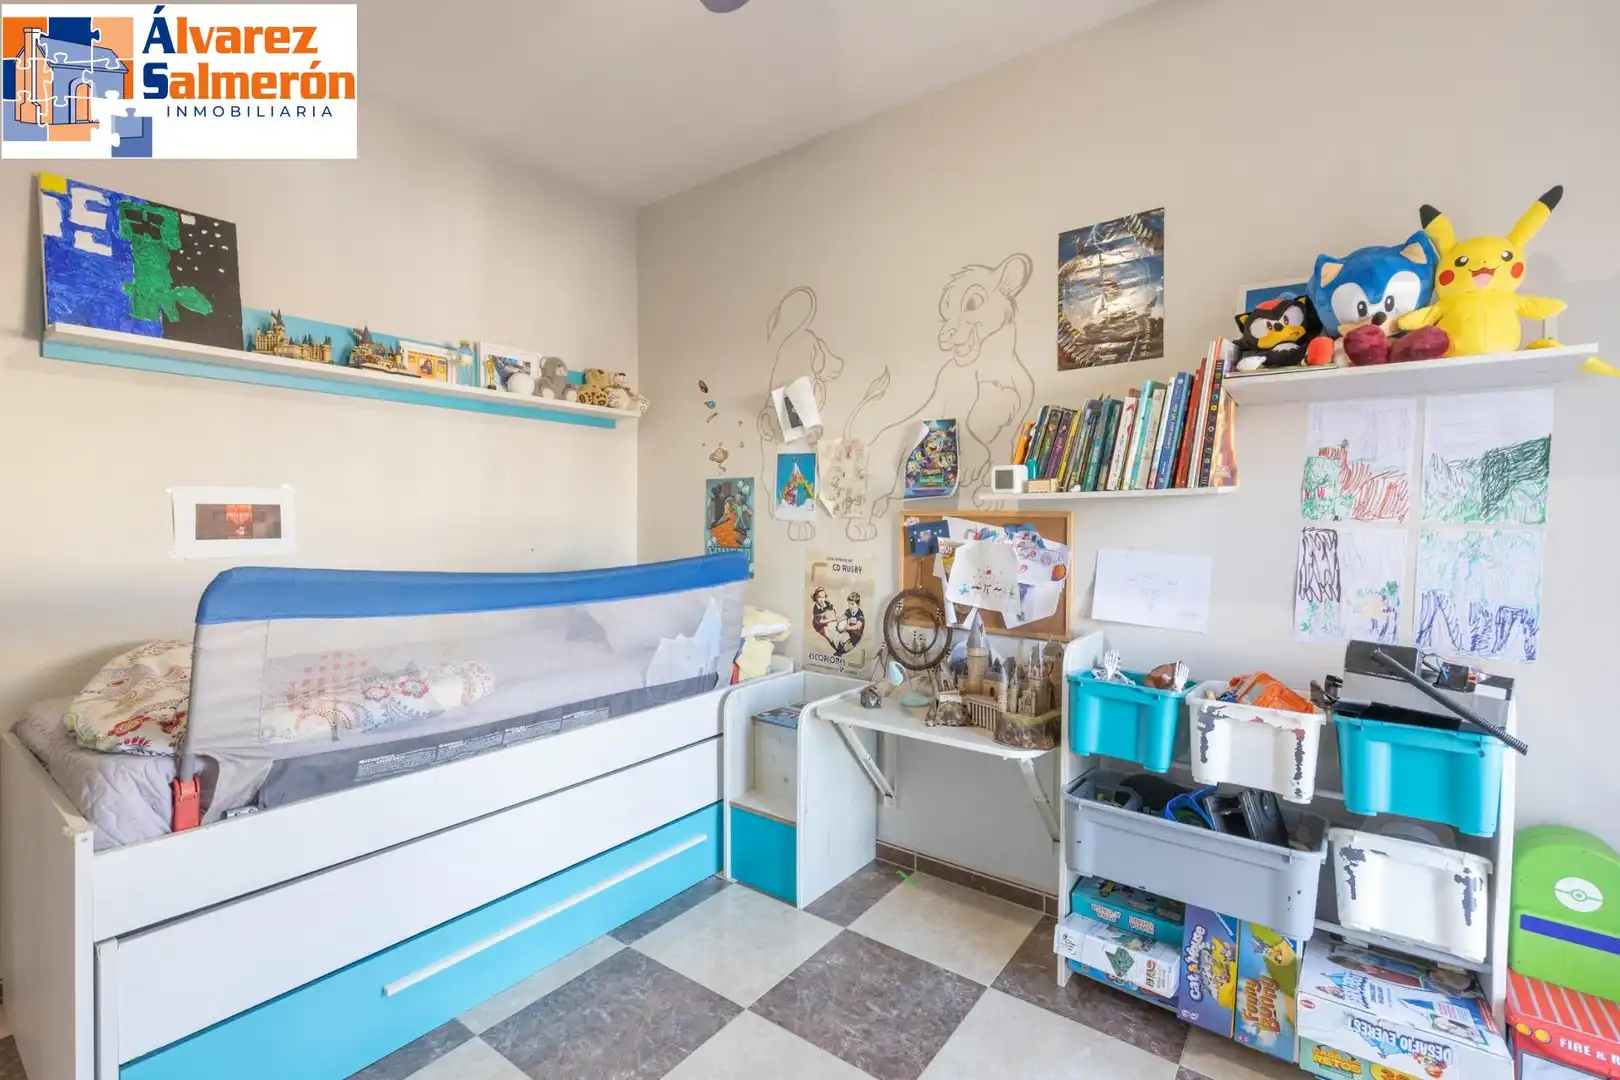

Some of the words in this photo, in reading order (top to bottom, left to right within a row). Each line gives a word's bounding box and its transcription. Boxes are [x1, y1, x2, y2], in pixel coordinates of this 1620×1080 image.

[832, 563, 841, 572] CD
[842, 564, 863, 573] RUGBY
[1185, 926, 1206, 964] Mouse
[1188, 971, 1203, 1001] Cat
[1241, 978, 1262, 1022] Funny
[1259, 975, 1279, 1031] Bunny
[1347, 1016, 1397, 1047] EVEREST
[1312, 1053, 1362, 1075] RETOS
[1560, 1038, 1592, 1057] FIRE
[1596, 1051, 1607, 1061] &
